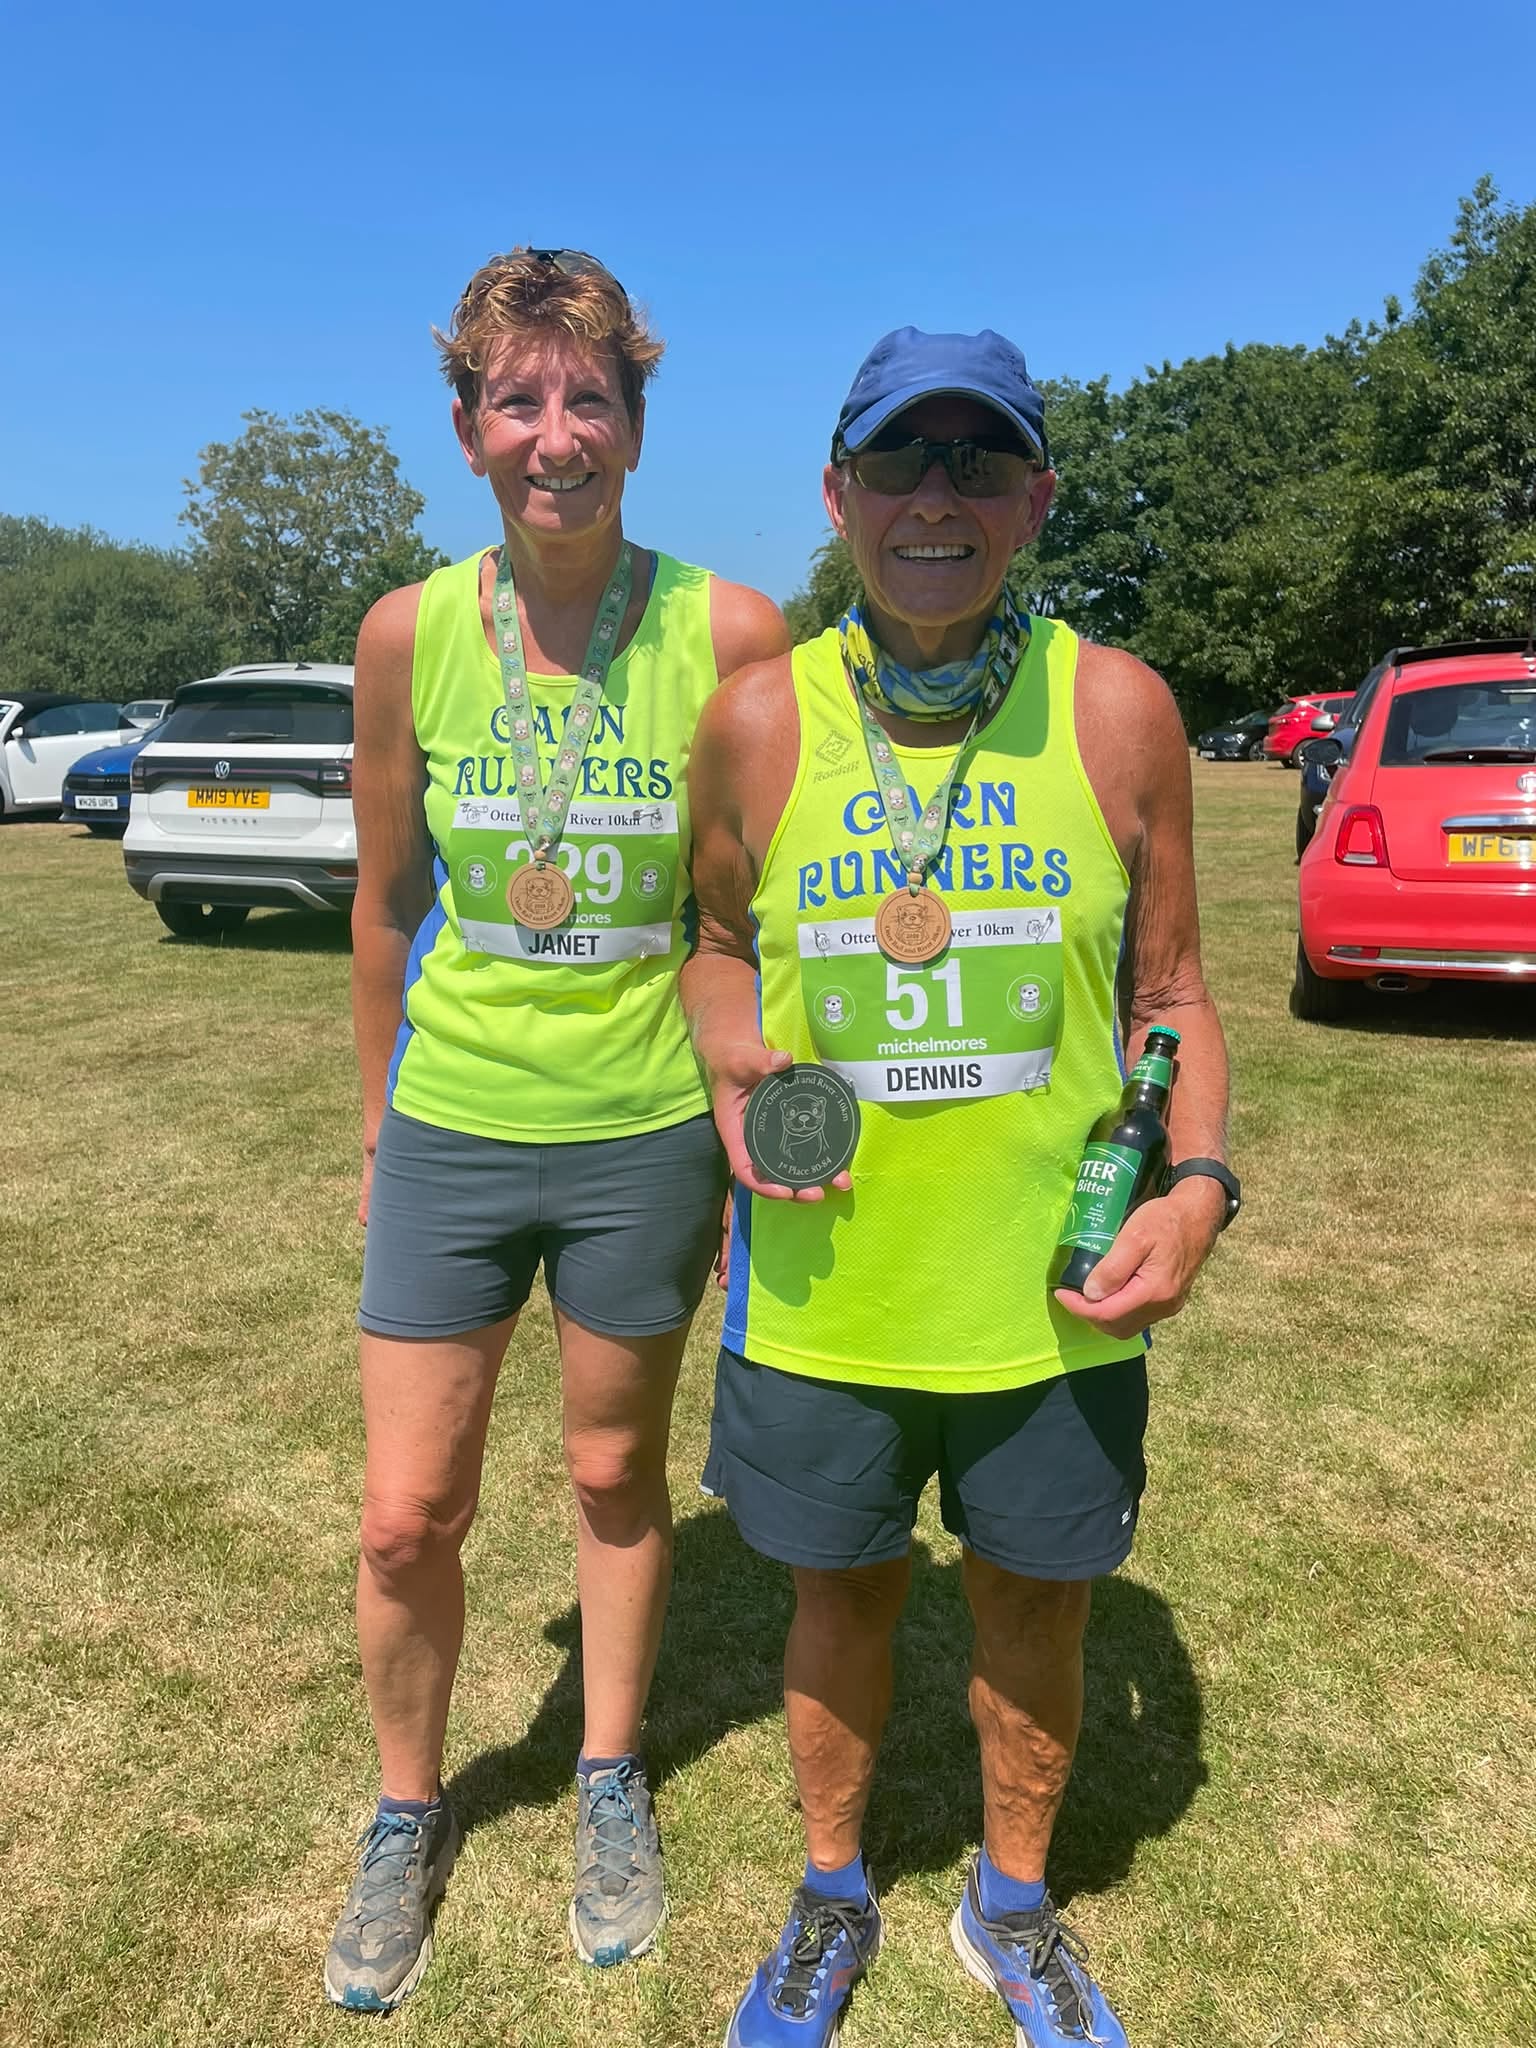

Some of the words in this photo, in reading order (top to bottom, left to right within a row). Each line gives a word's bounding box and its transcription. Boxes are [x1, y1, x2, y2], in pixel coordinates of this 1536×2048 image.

[196, 788, 228, 805] MM19
[231, 788, 260, 805] YVE
[570, 813, 604, 826] River
[607, 814, 641, 827] 10km
[976, 923, 1014, 937] 10km
[528, 934, 601, 957] JANET
[885, 957, 964, 1031] 51
[877, 1035, 988, 1056] michelmores
[886, 1063, 983, 1092] DENNIS
[765, 1085, 784, 1106] Otter
[801, 1075, 816, 1084] and
[816, 1078, 836, 1096] River
[787, 1165, 809, 1176] Place
[1076, 1179, 1113, 1198] Bitter
